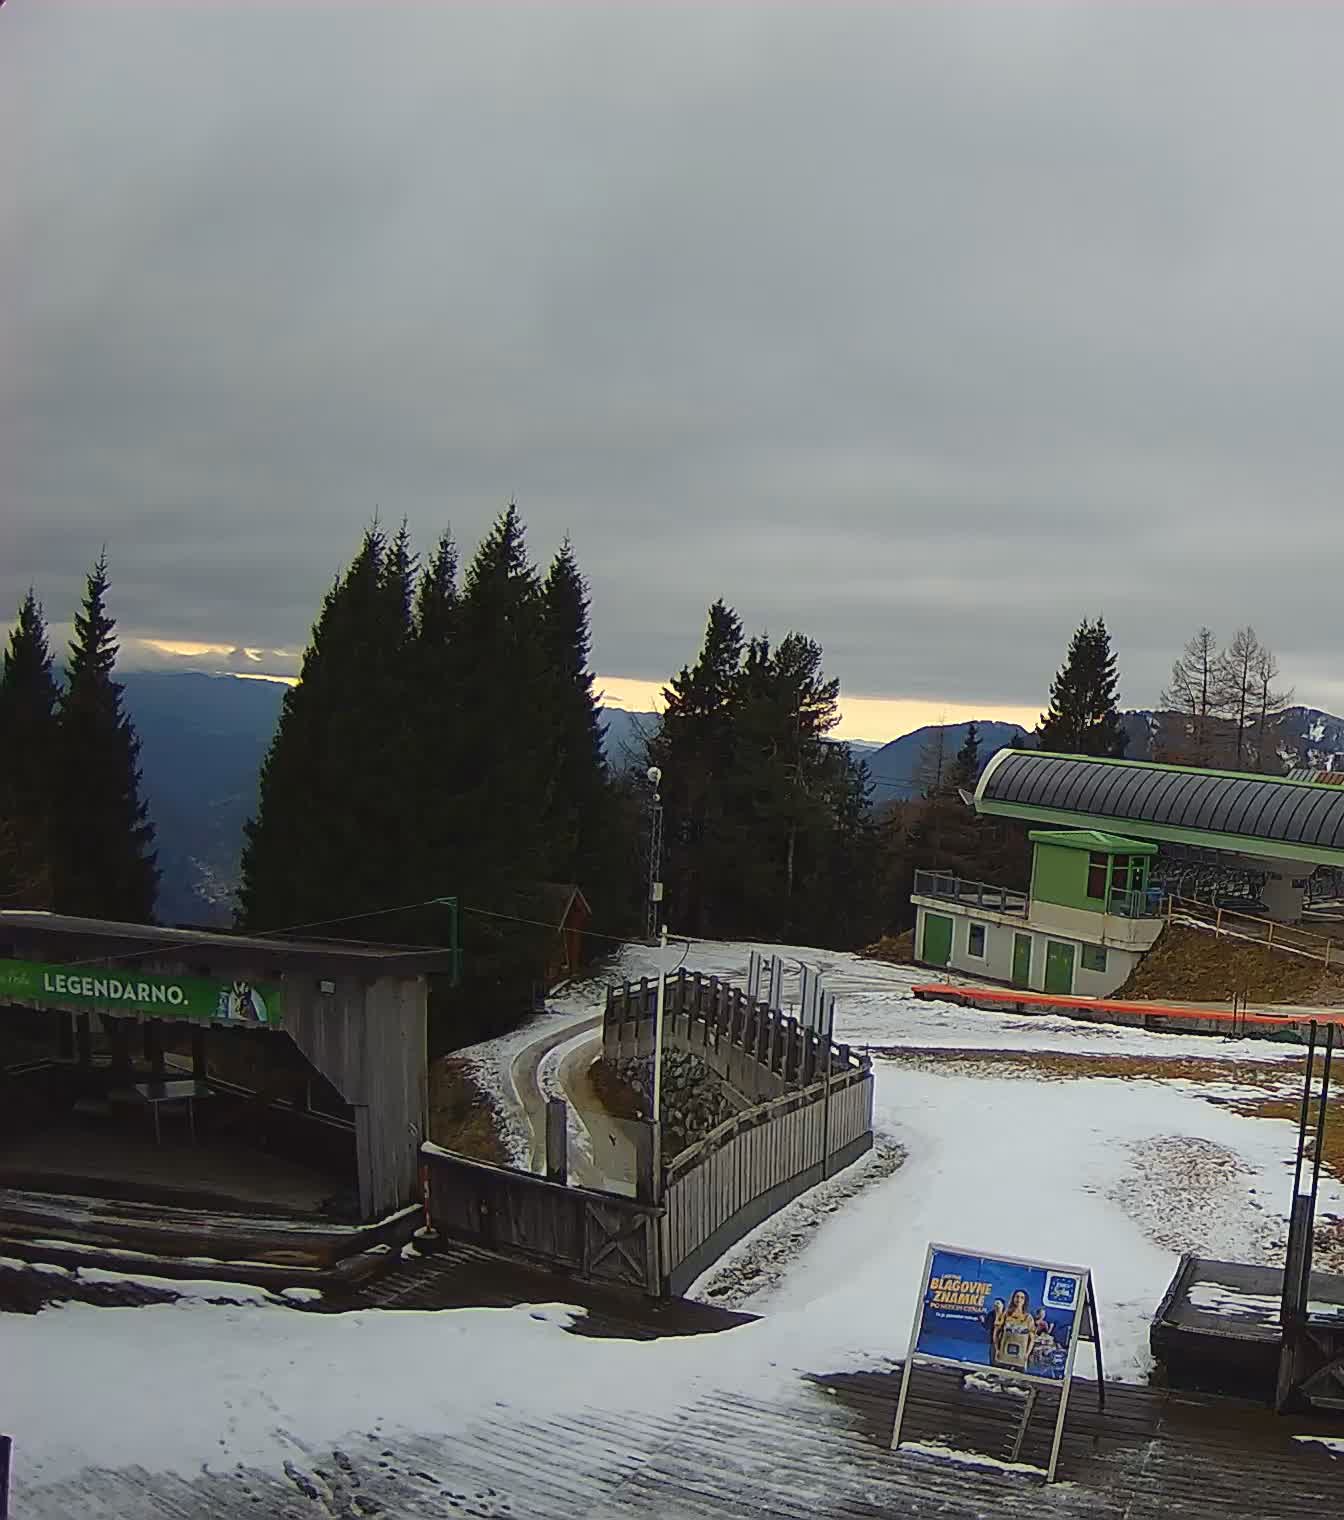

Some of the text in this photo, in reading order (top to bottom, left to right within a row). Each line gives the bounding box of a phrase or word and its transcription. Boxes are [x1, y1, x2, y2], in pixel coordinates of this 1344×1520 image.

[44, 972, 189, 1004] LEGENDARNO.
[930, 1277, 992, 1295] BLAGOVNE
[933, 1290, 985, 1307] ZNAMKE
